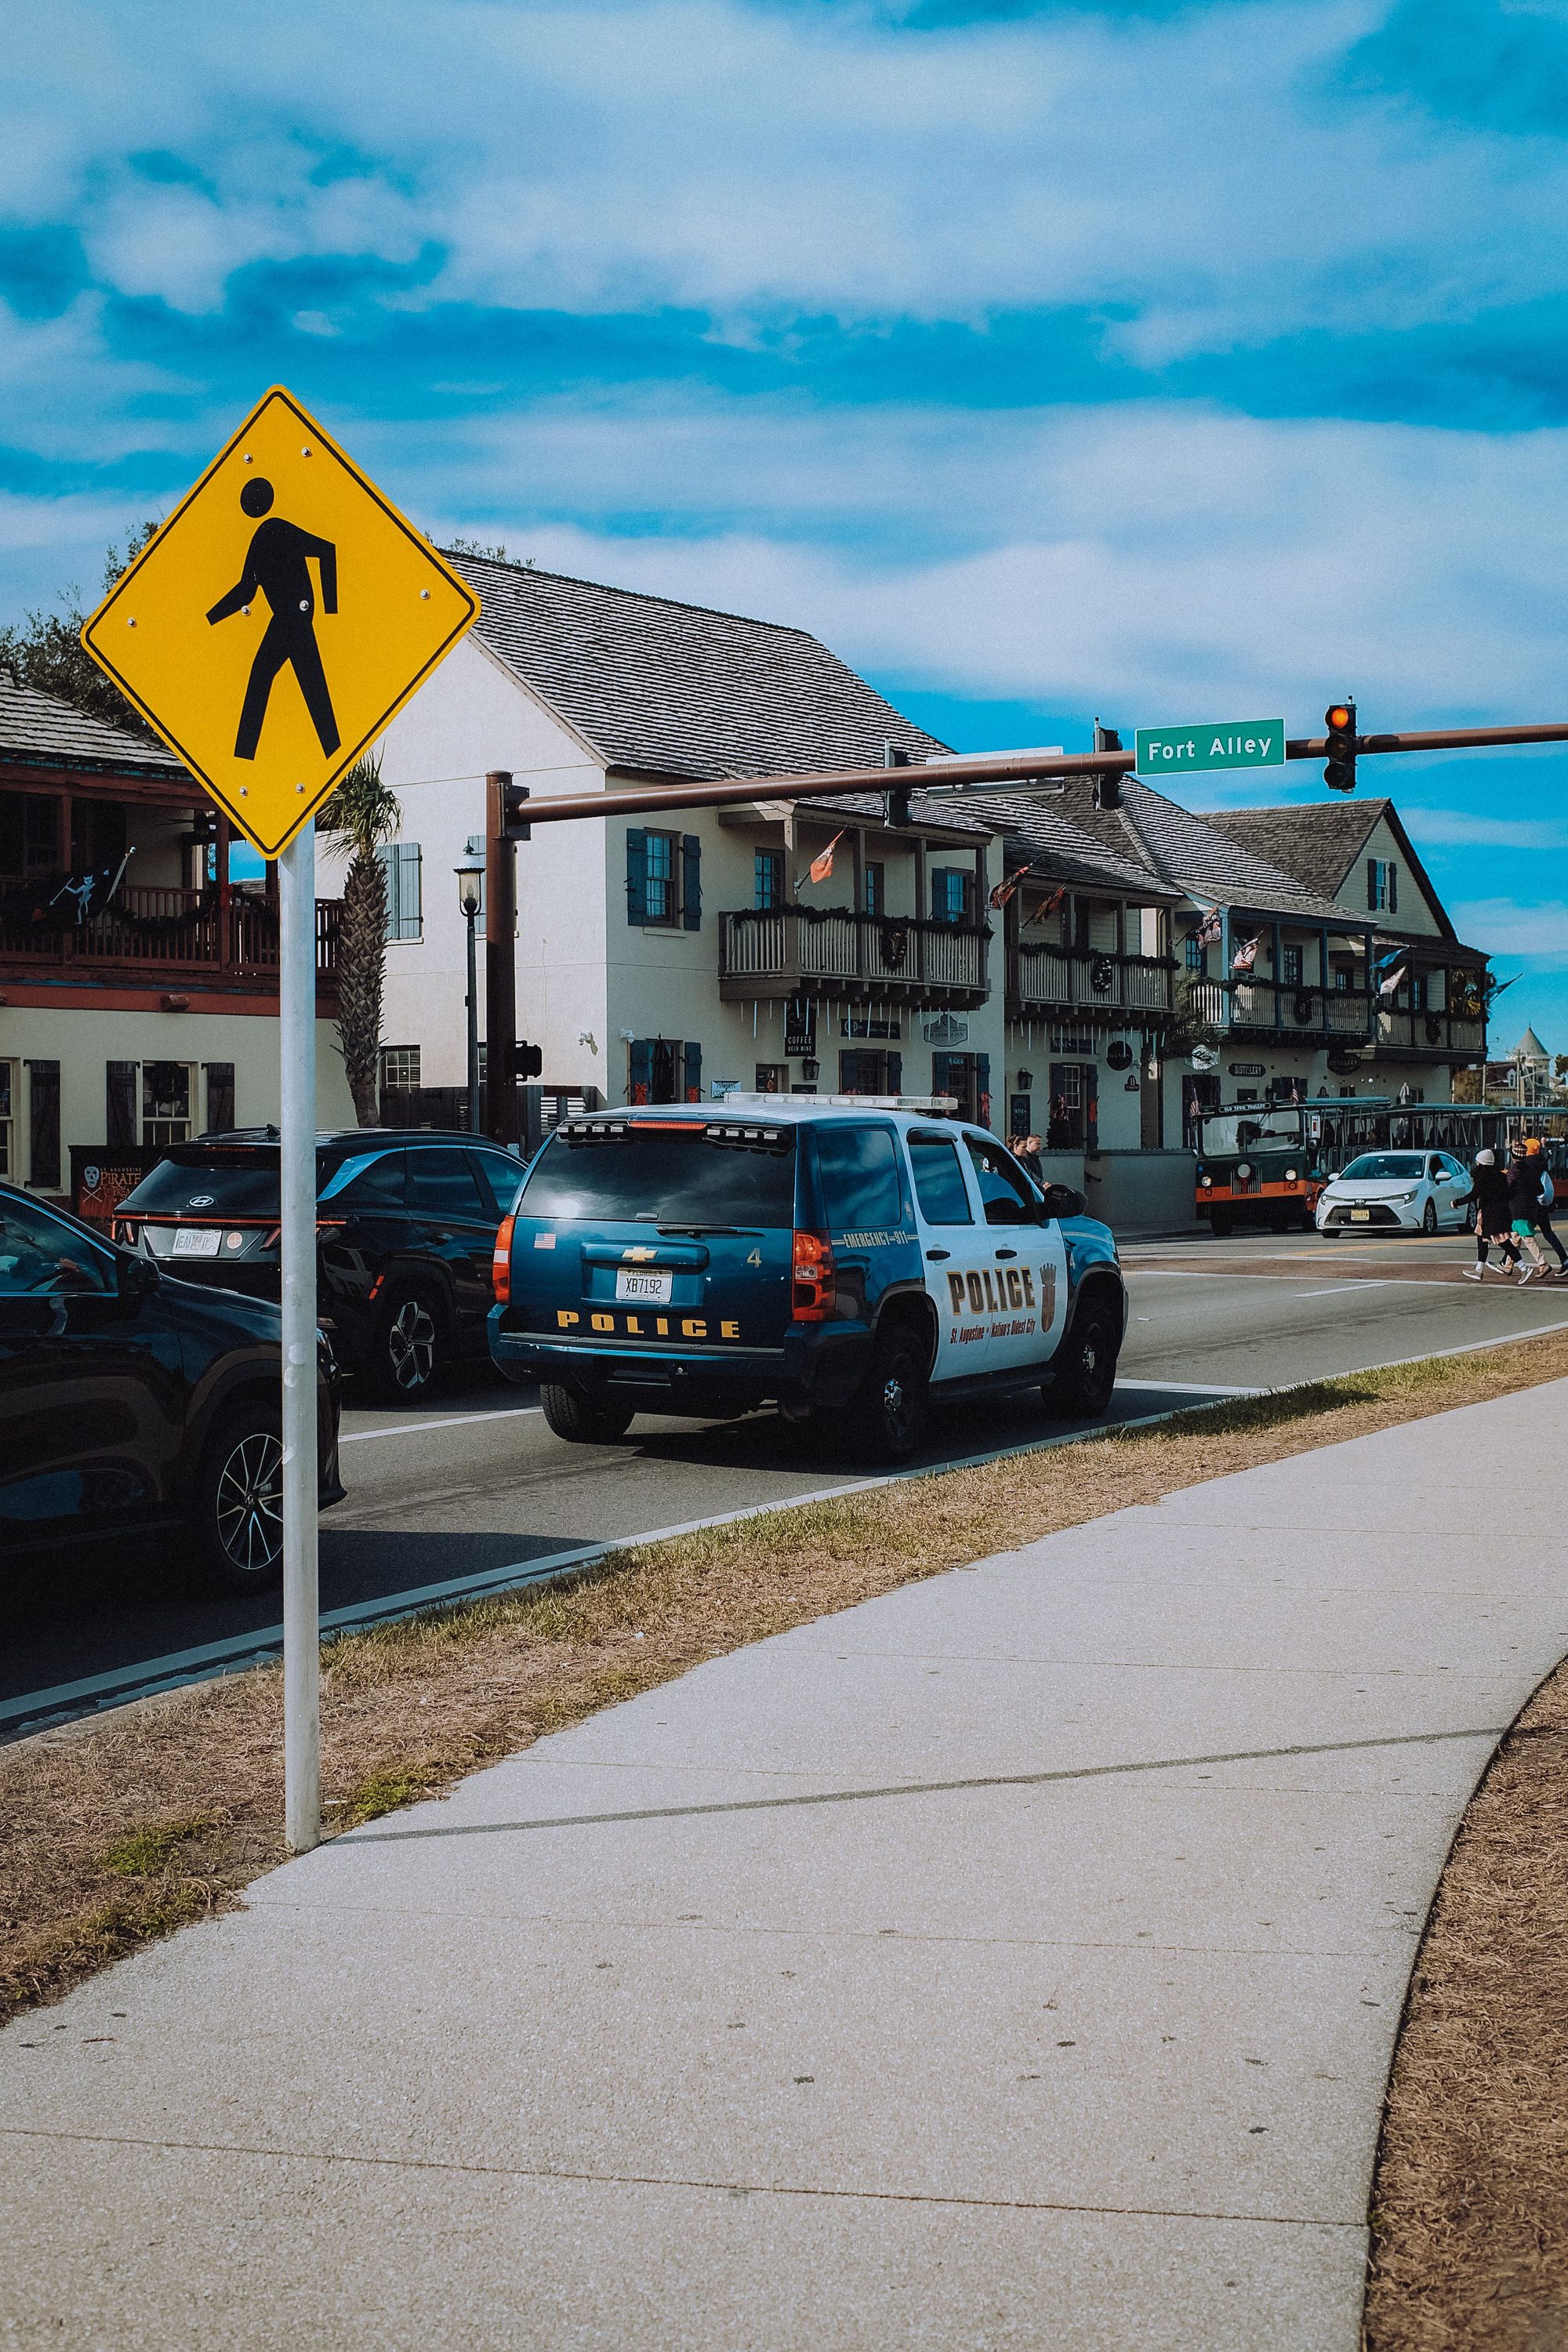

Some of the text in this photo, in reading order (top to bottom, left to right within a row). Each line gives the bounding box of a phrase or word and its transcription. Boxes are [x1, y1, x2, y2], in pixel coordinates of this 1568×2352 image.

[1149, 736, 1272, 760] Fort Alley
[788, 1036, 812, 1044] COFFEE
[1234, 1065, 1261, 1075] DISTILLERY
[843, 1232, 891, 1248] EMERGENCY
[747, 1247, 762, 1268] 4
[626, 1277, 662, 1294] XB7192
[946, 1266, 1036, 1316] POLICE
[557, 1310, 740, 1338] POLICE
[959, 1325, 985, 1345] Augustine
[1011, 1319, 1026, 1335] Oldest
[1026, 1318, 1036, 1335] City
